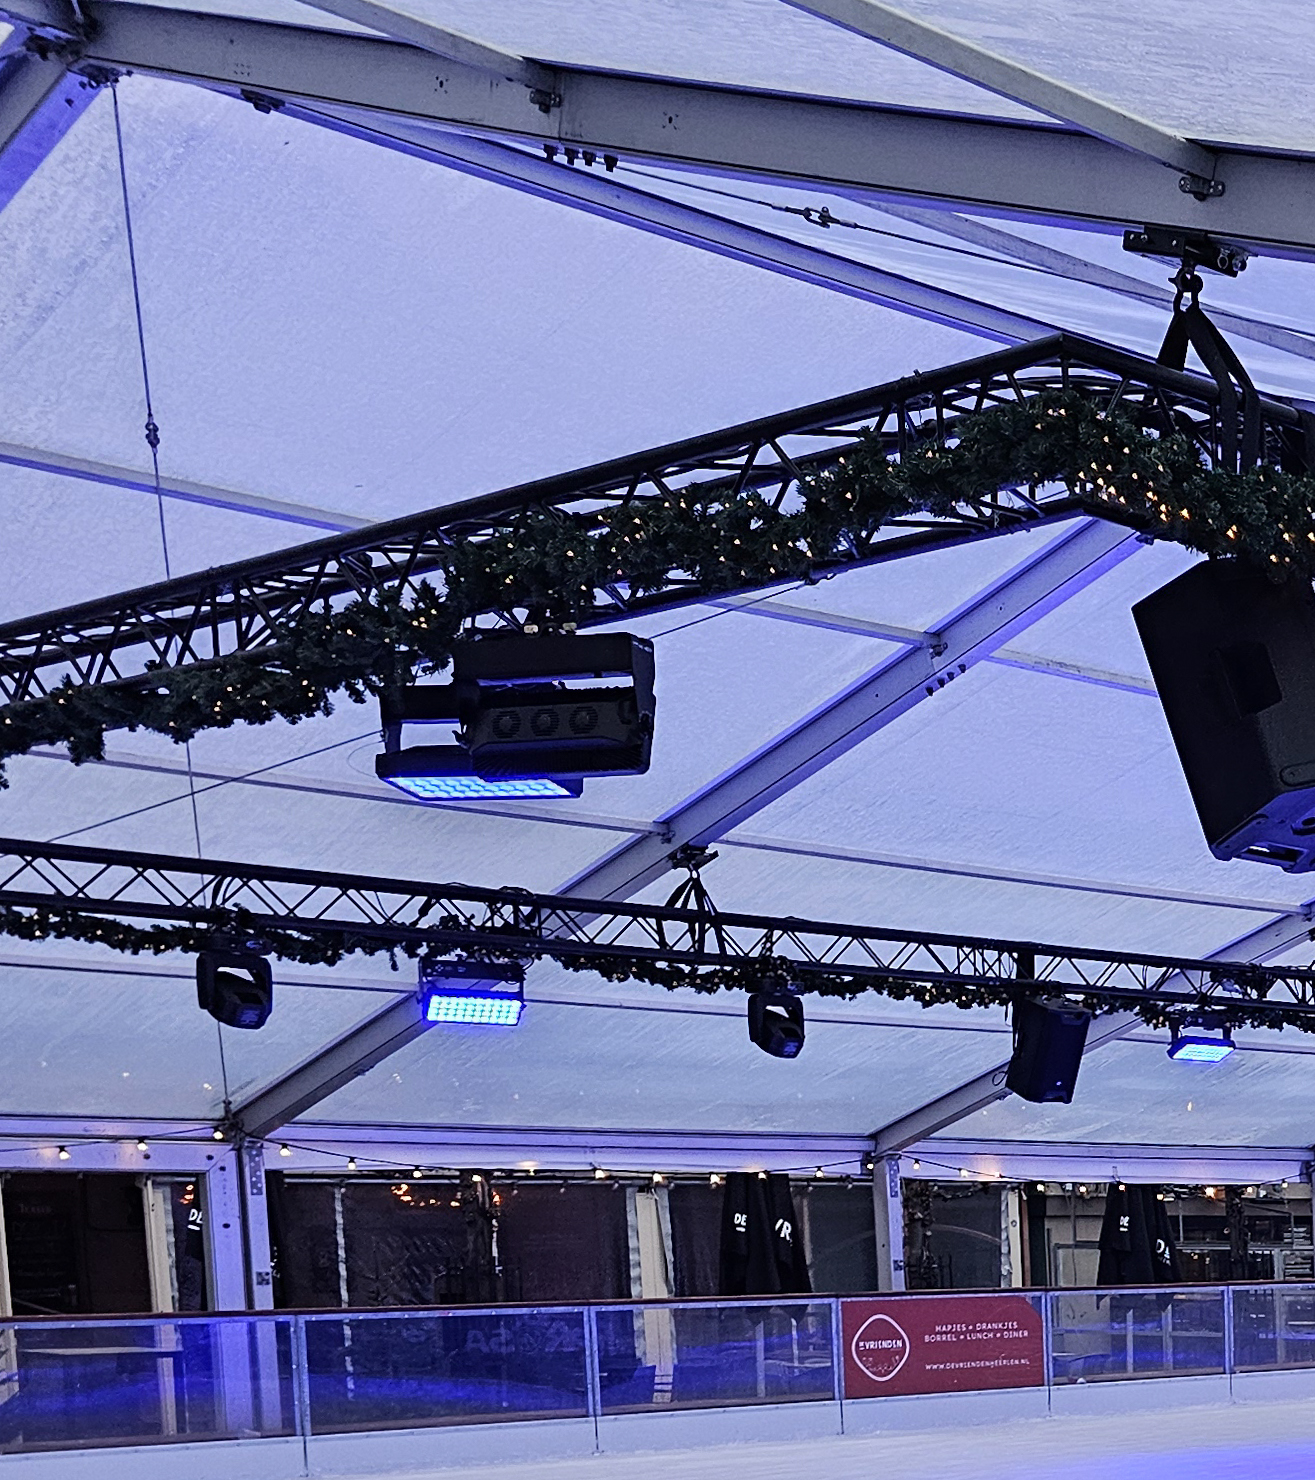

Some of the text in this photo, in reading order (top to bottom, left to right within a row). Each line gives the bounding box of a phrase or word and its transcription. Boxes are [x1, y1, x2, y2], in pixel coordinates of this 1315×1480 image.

[734, 1213, 747, 1226] DE
[935, 1321, 1018, 1332] HAPJES DRANKJES
[924, 1330, 1029, 1343] BORREL LUNCH DINER
